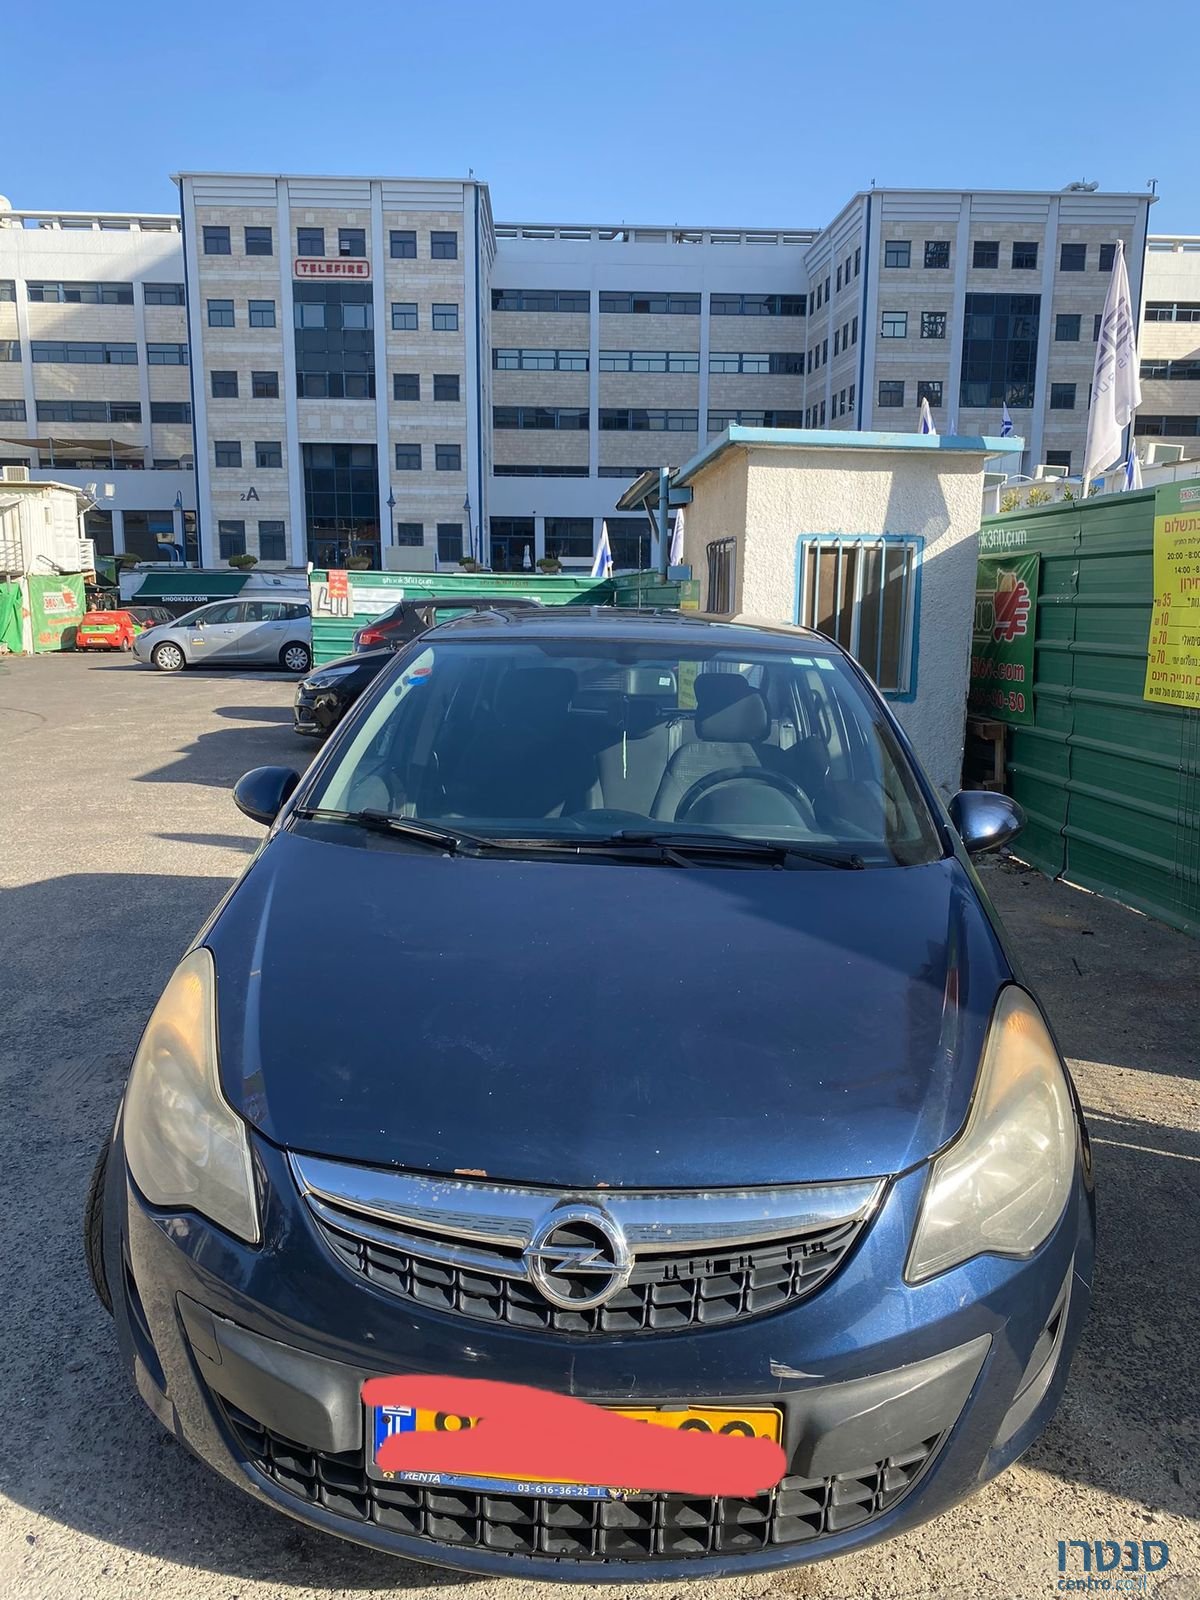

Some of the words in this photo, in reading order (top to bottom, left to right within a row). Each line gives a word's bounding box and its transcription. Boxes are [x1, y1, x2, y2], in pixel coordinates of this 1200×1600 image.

[301, 264, 364, 274] TELEFIRE
[1158, 631, 1167, 645] 70
[1156, 650, 1165, 665] 70
[1151, 671, 1168, 682] חינם
[404, 1472, 441, 1483] RENTA
[518, 1484, 589, 1496] 03-616-36-25
